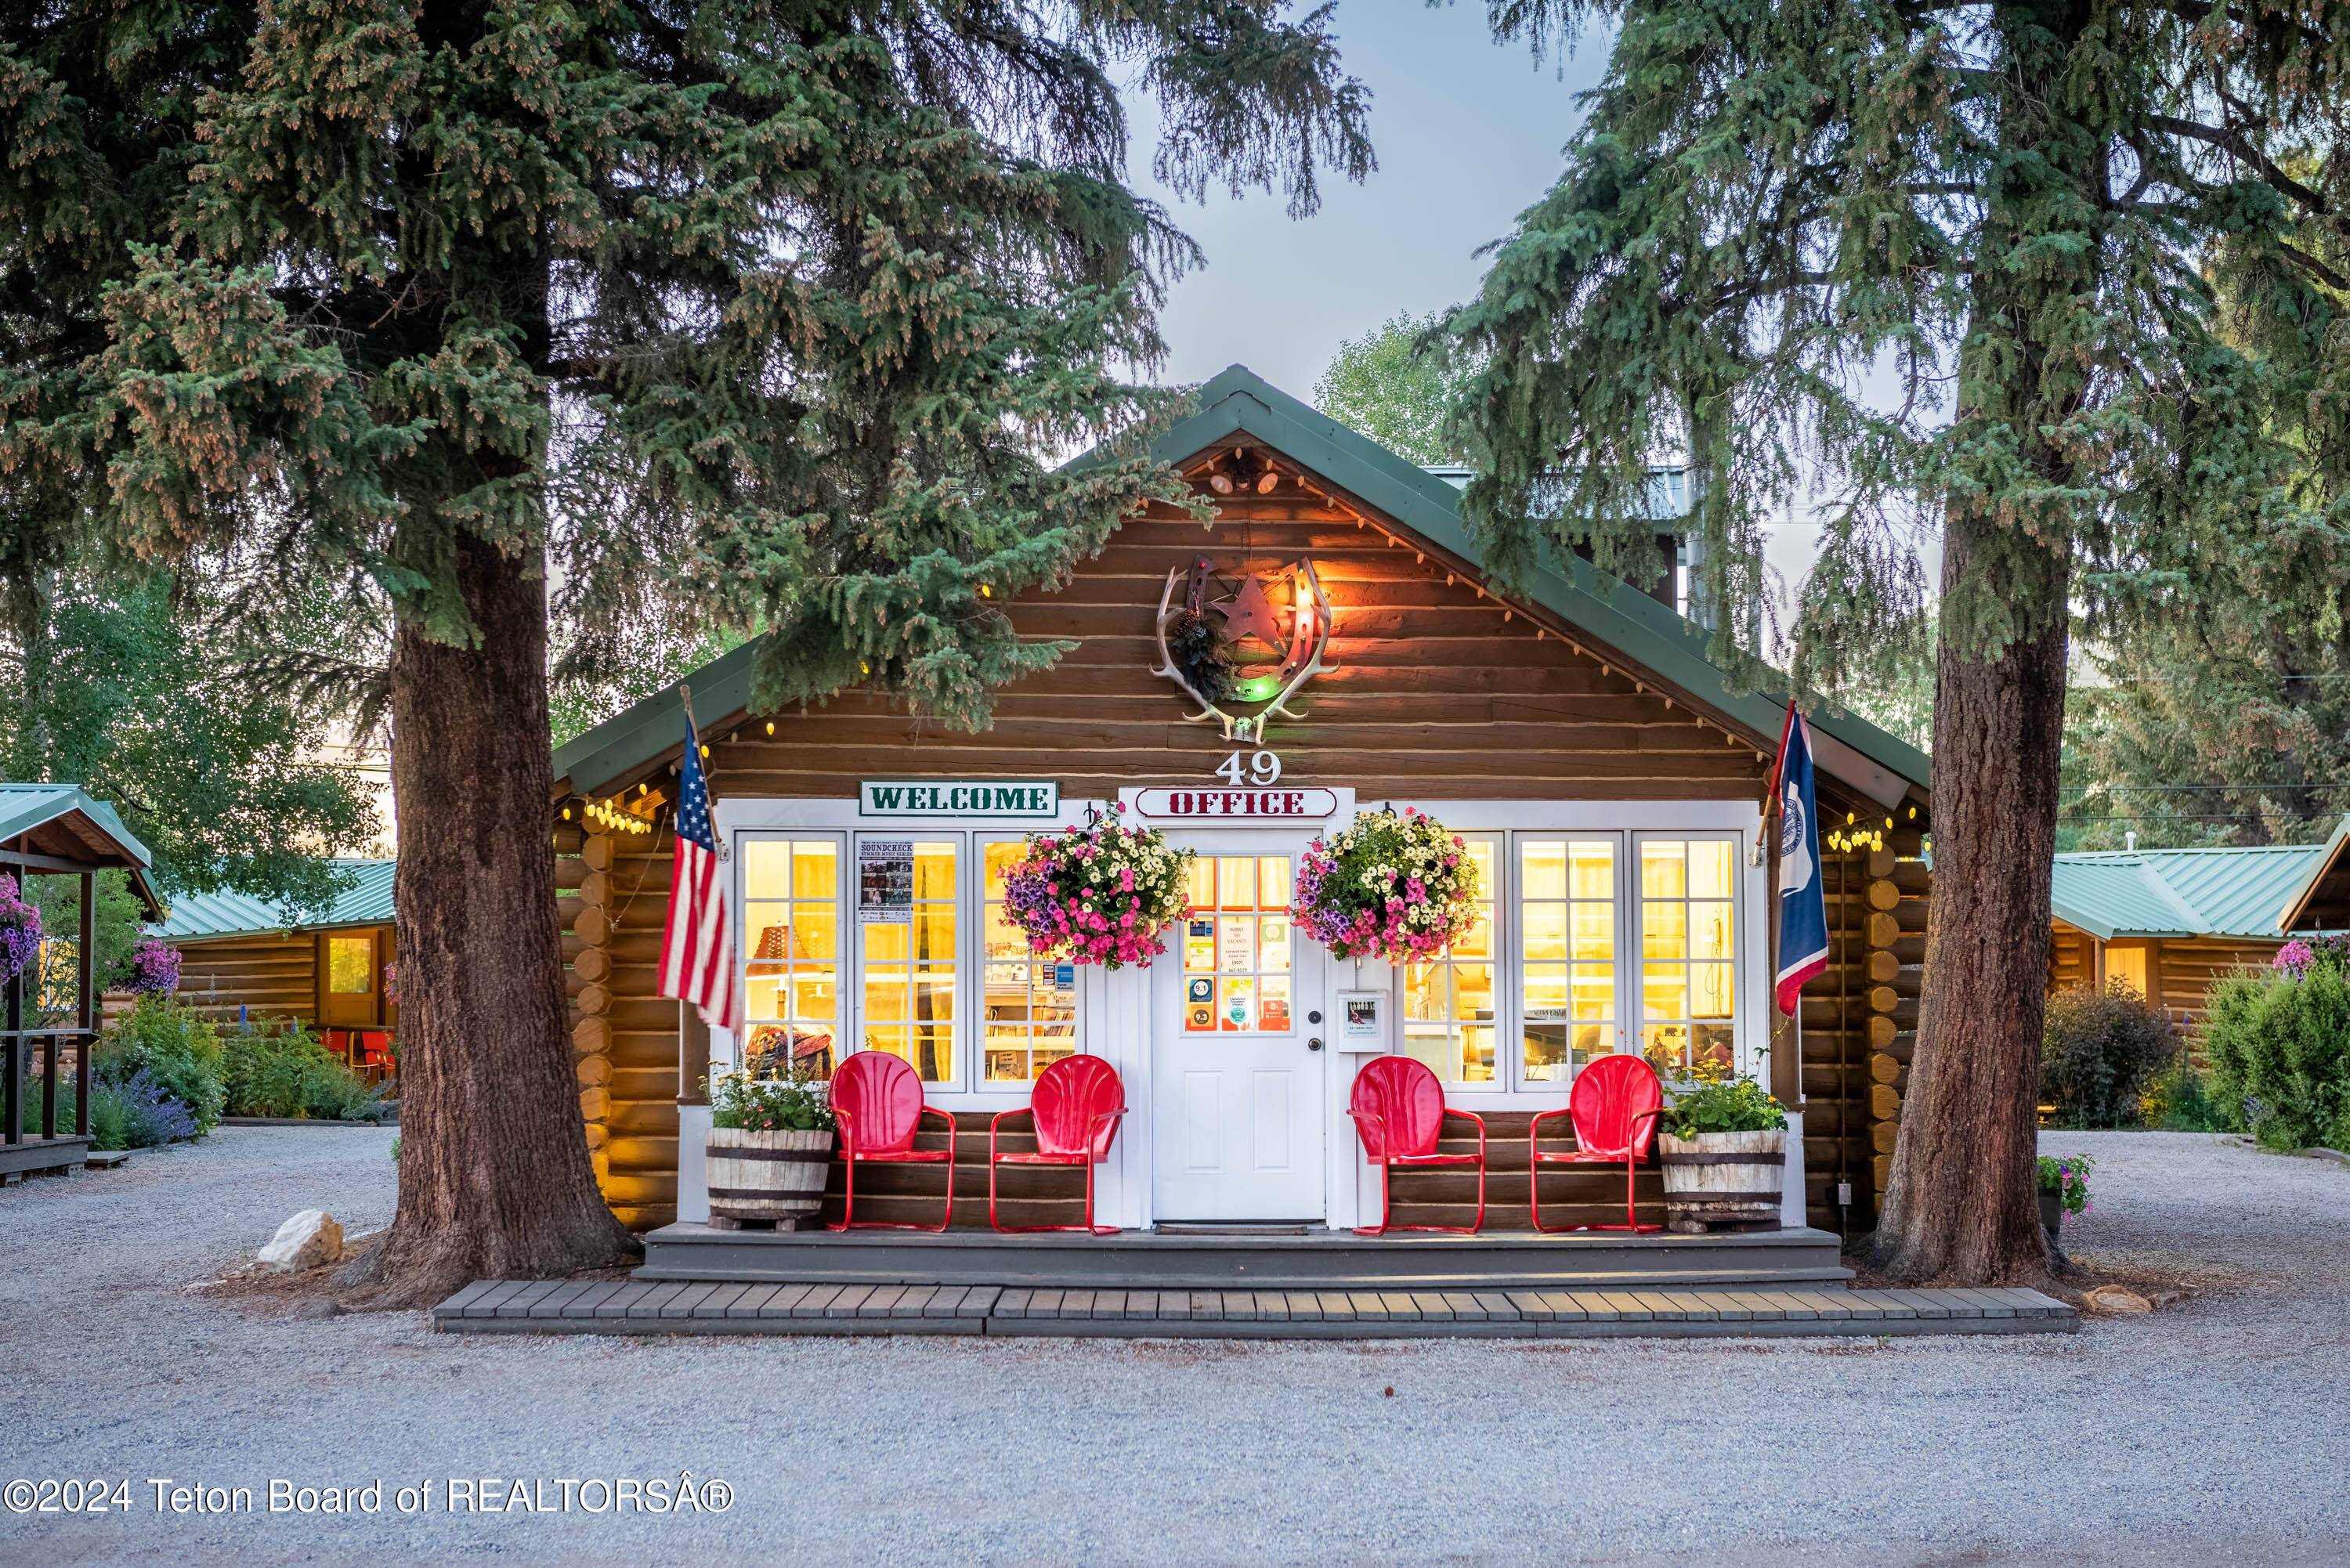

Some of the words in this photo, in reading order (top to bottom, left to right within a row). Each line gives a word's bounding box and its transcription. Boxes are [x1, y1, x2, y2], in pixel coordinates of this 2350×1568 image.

[1215, 750, 1282, 786] 49
[869, 786, 1048, 811] WELCOME
[1169, 793, 1304, 815] OFFICE
